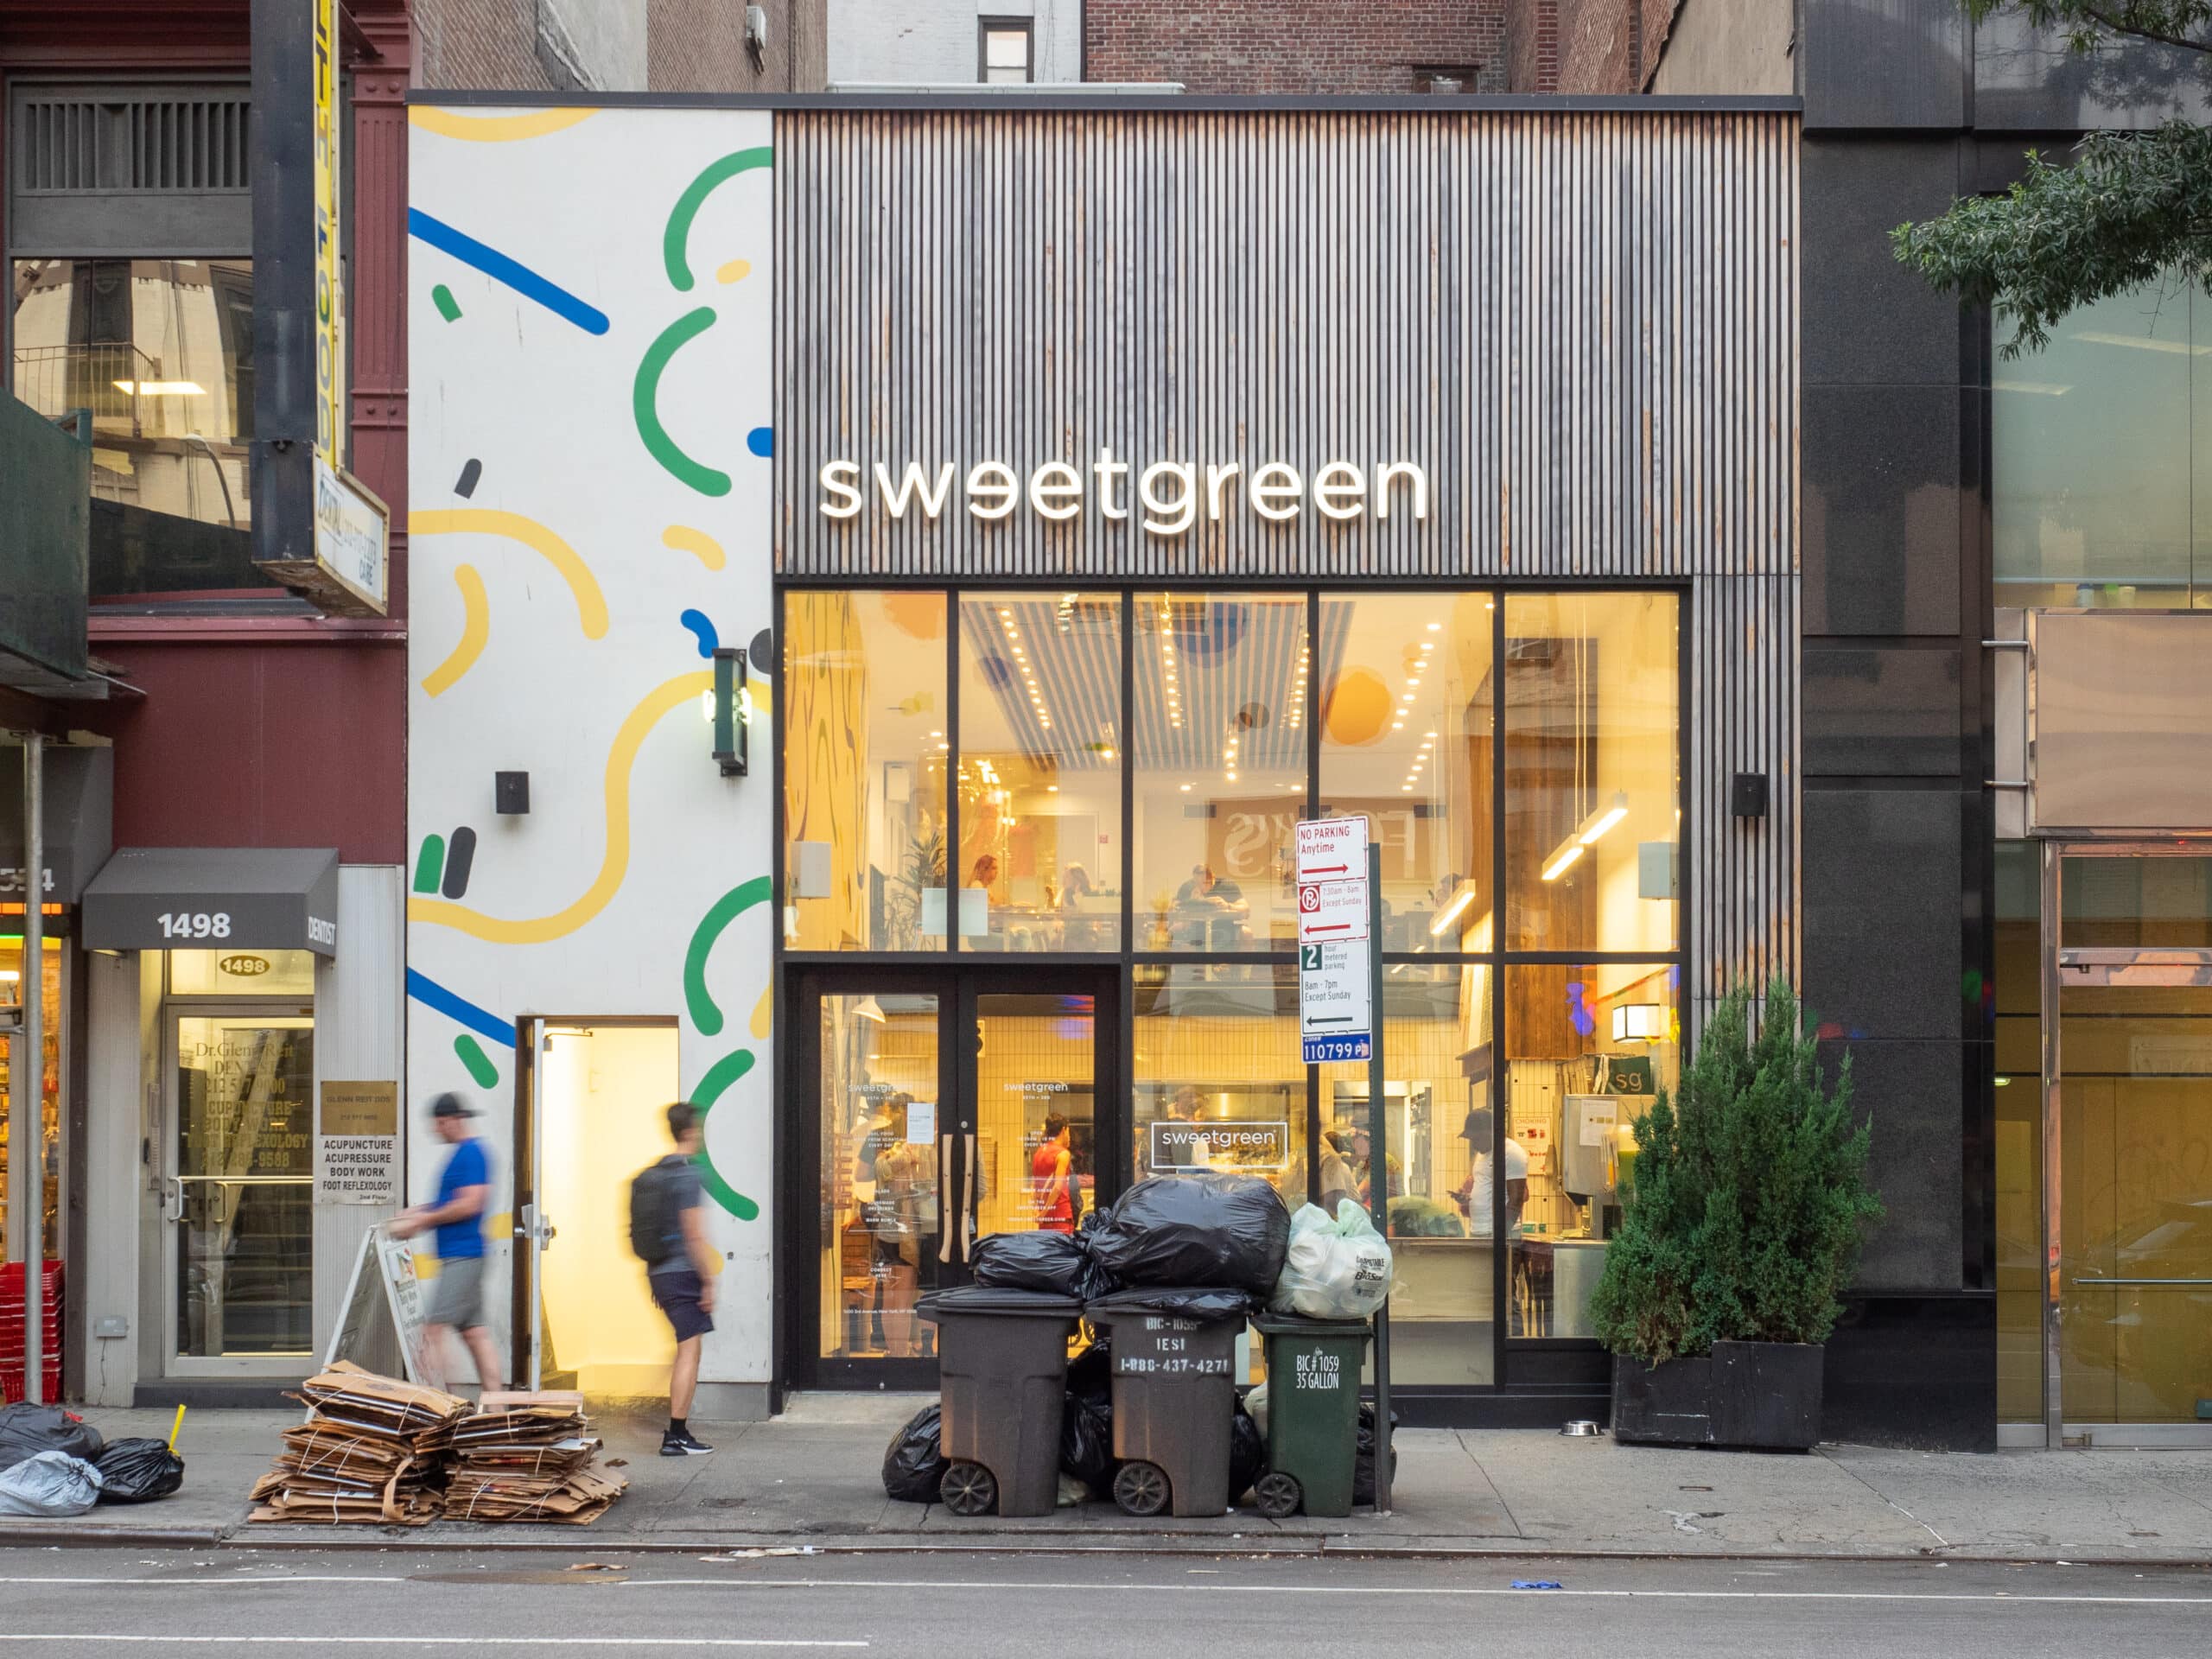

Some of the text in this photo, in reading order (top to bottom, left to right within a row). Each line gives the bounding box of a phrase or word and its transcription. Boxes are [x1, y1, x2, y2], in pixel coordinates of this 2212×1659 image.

[317, 204, 331, 453] FOOD
[818, 446, 1427, 535] sweetgreen
[1300, 825, 1350, 841] NO PARKING
[1301, 842, 1335, 855] Anytime
[157, 912, 231, 938] 1498
[308, 916, 336, 946] DENTIST
[1306, 945, 1318, 969] 2
[223, 959, 266, 973] 1498
[1305, 991, 1351, 1002] Except Sunday
[1304, 1043, 1352, 1060] 110799
[1003, 1082, 1069, 1093] sweetgreen
[1616, 1071, 1643, 1092] sg
[200, 1101, 293, 1116] CUPUNCTURE
[323, 1140, 393, 1149] ACUPUNCTURE
[1162, 1129, 1275, 1147] sweetgreen
[325, 1154, 392, 1163] ACUPRESSURE
[330, 1167, 385, 1177] BODY WORK
[322, 1181, 392, 1191] FOOT REFLEXOLOGY
[1156, 1338, 1185, 1351] IESI
[1296, 1356, 1310, 1372] BIC
[1319, 1355, 1339, 1371] 1059
[1296, 1373, 1339, 1389] 35 GALLON
